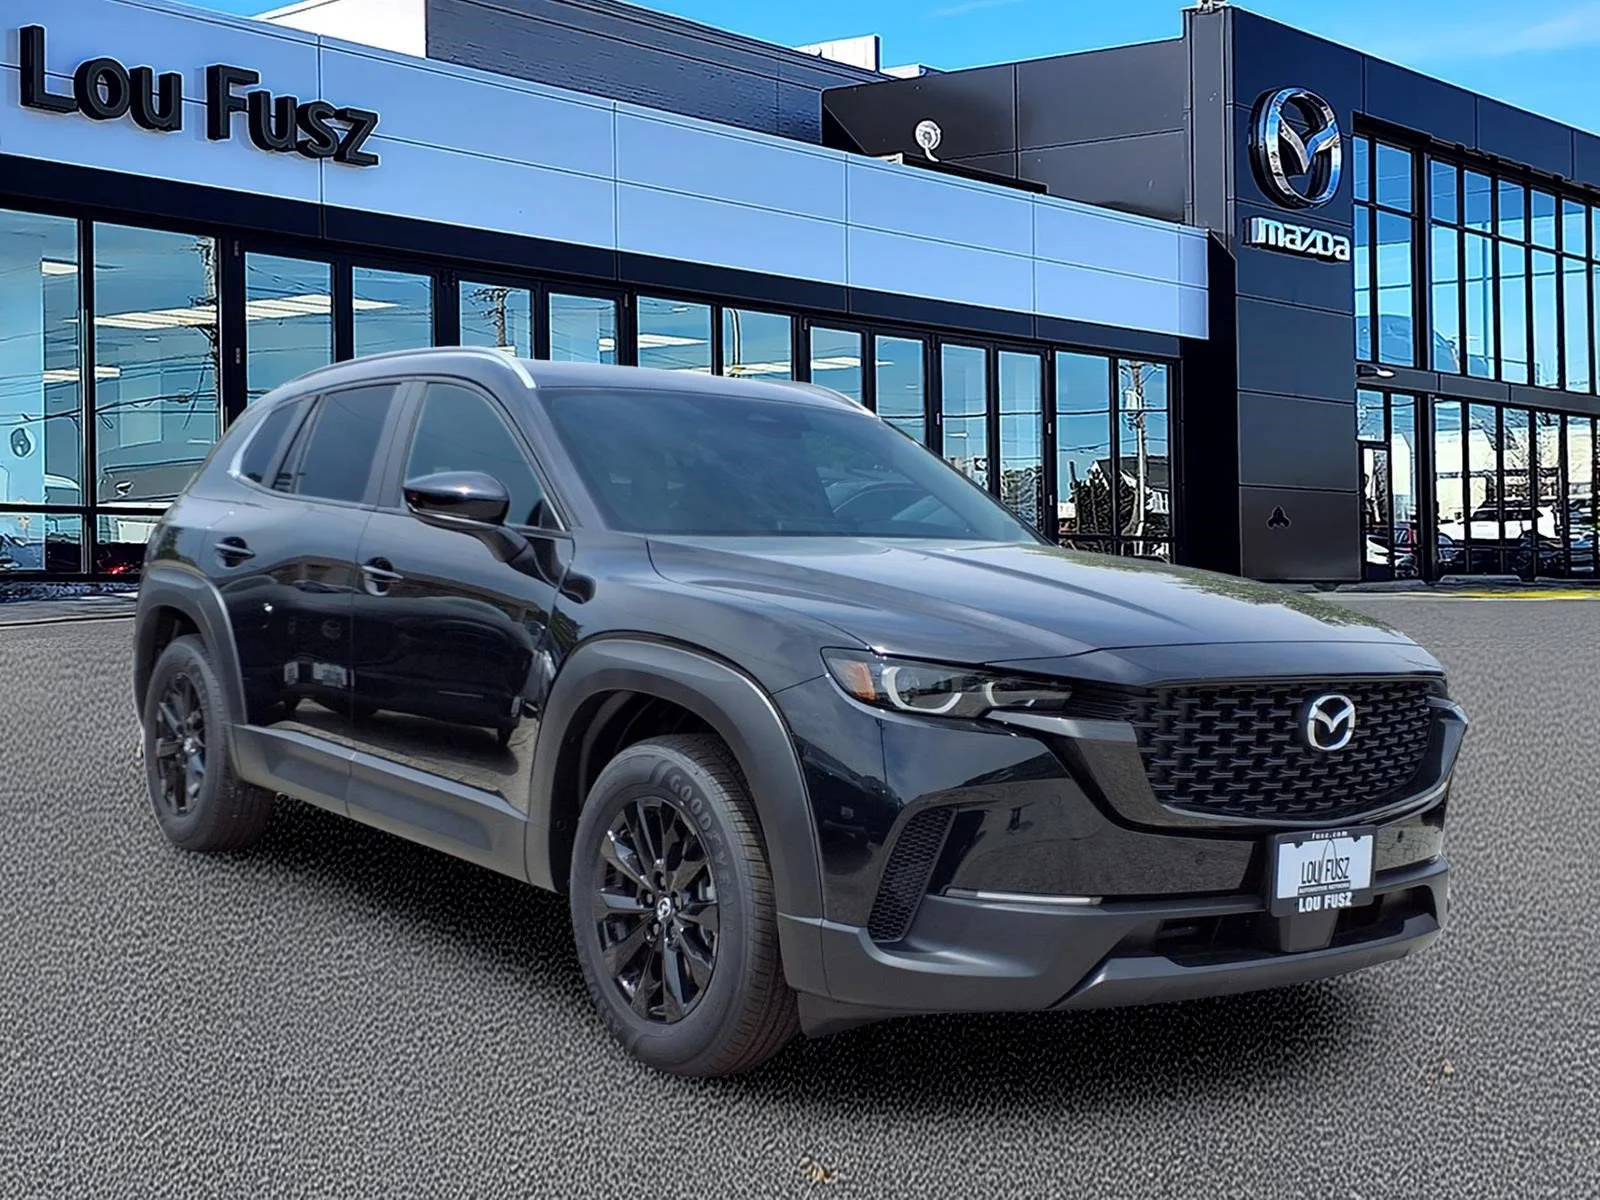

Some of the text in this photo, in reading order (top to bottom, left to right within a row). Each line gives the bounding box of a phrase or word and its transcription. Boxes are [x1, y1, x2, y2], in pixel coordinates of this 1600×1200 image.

[19, 24, 380, 167] Lou Fusz
[1301, 857, 1351, 885] LOU FUSZ
[1298, 892, 1352, 913] LOU FUSZ
